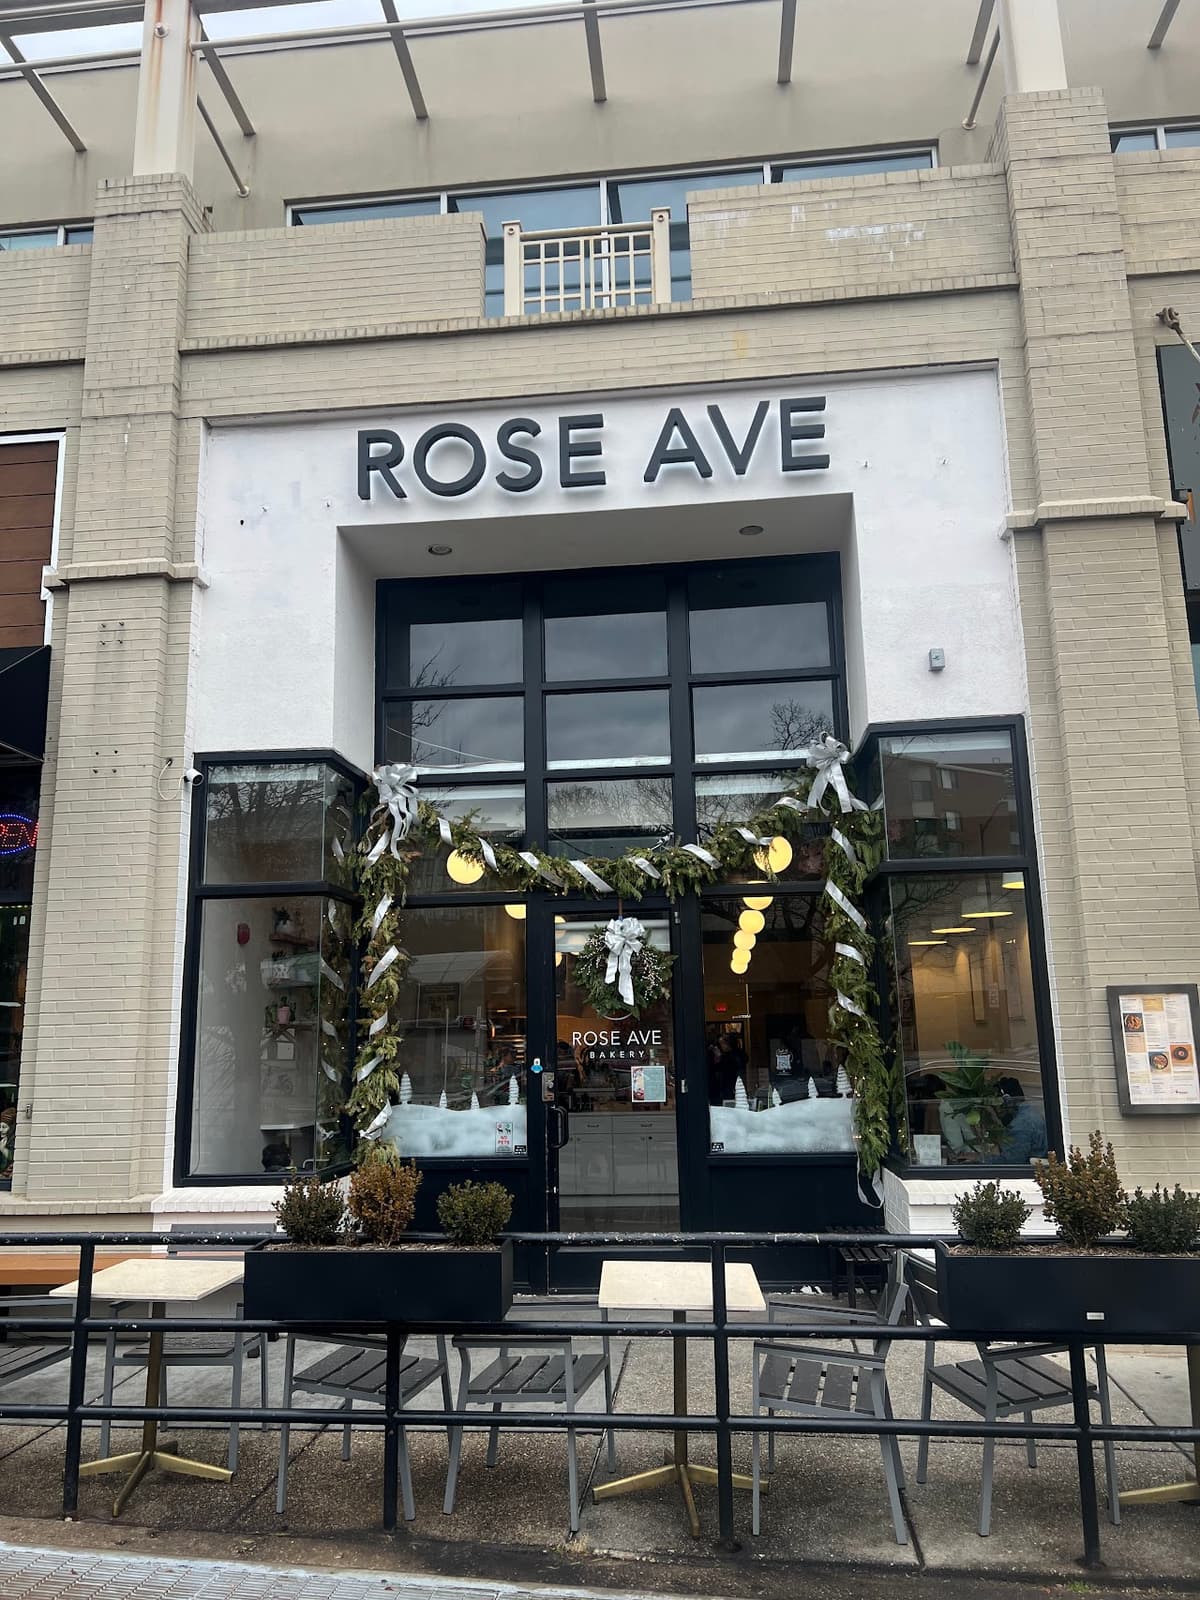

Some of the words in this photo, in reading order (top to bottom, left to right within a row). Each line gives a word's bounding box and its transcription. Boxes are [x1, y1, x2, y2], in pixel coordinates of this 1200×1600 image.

[357, 413, 606, 501] ROSE
[643, 396, 830, 483] AVE
[572, 1031, 621, 1046] ROSE
[626, 1030, 662, 1045] AVE
[589, 1051, 645, 1059] BAKERY
